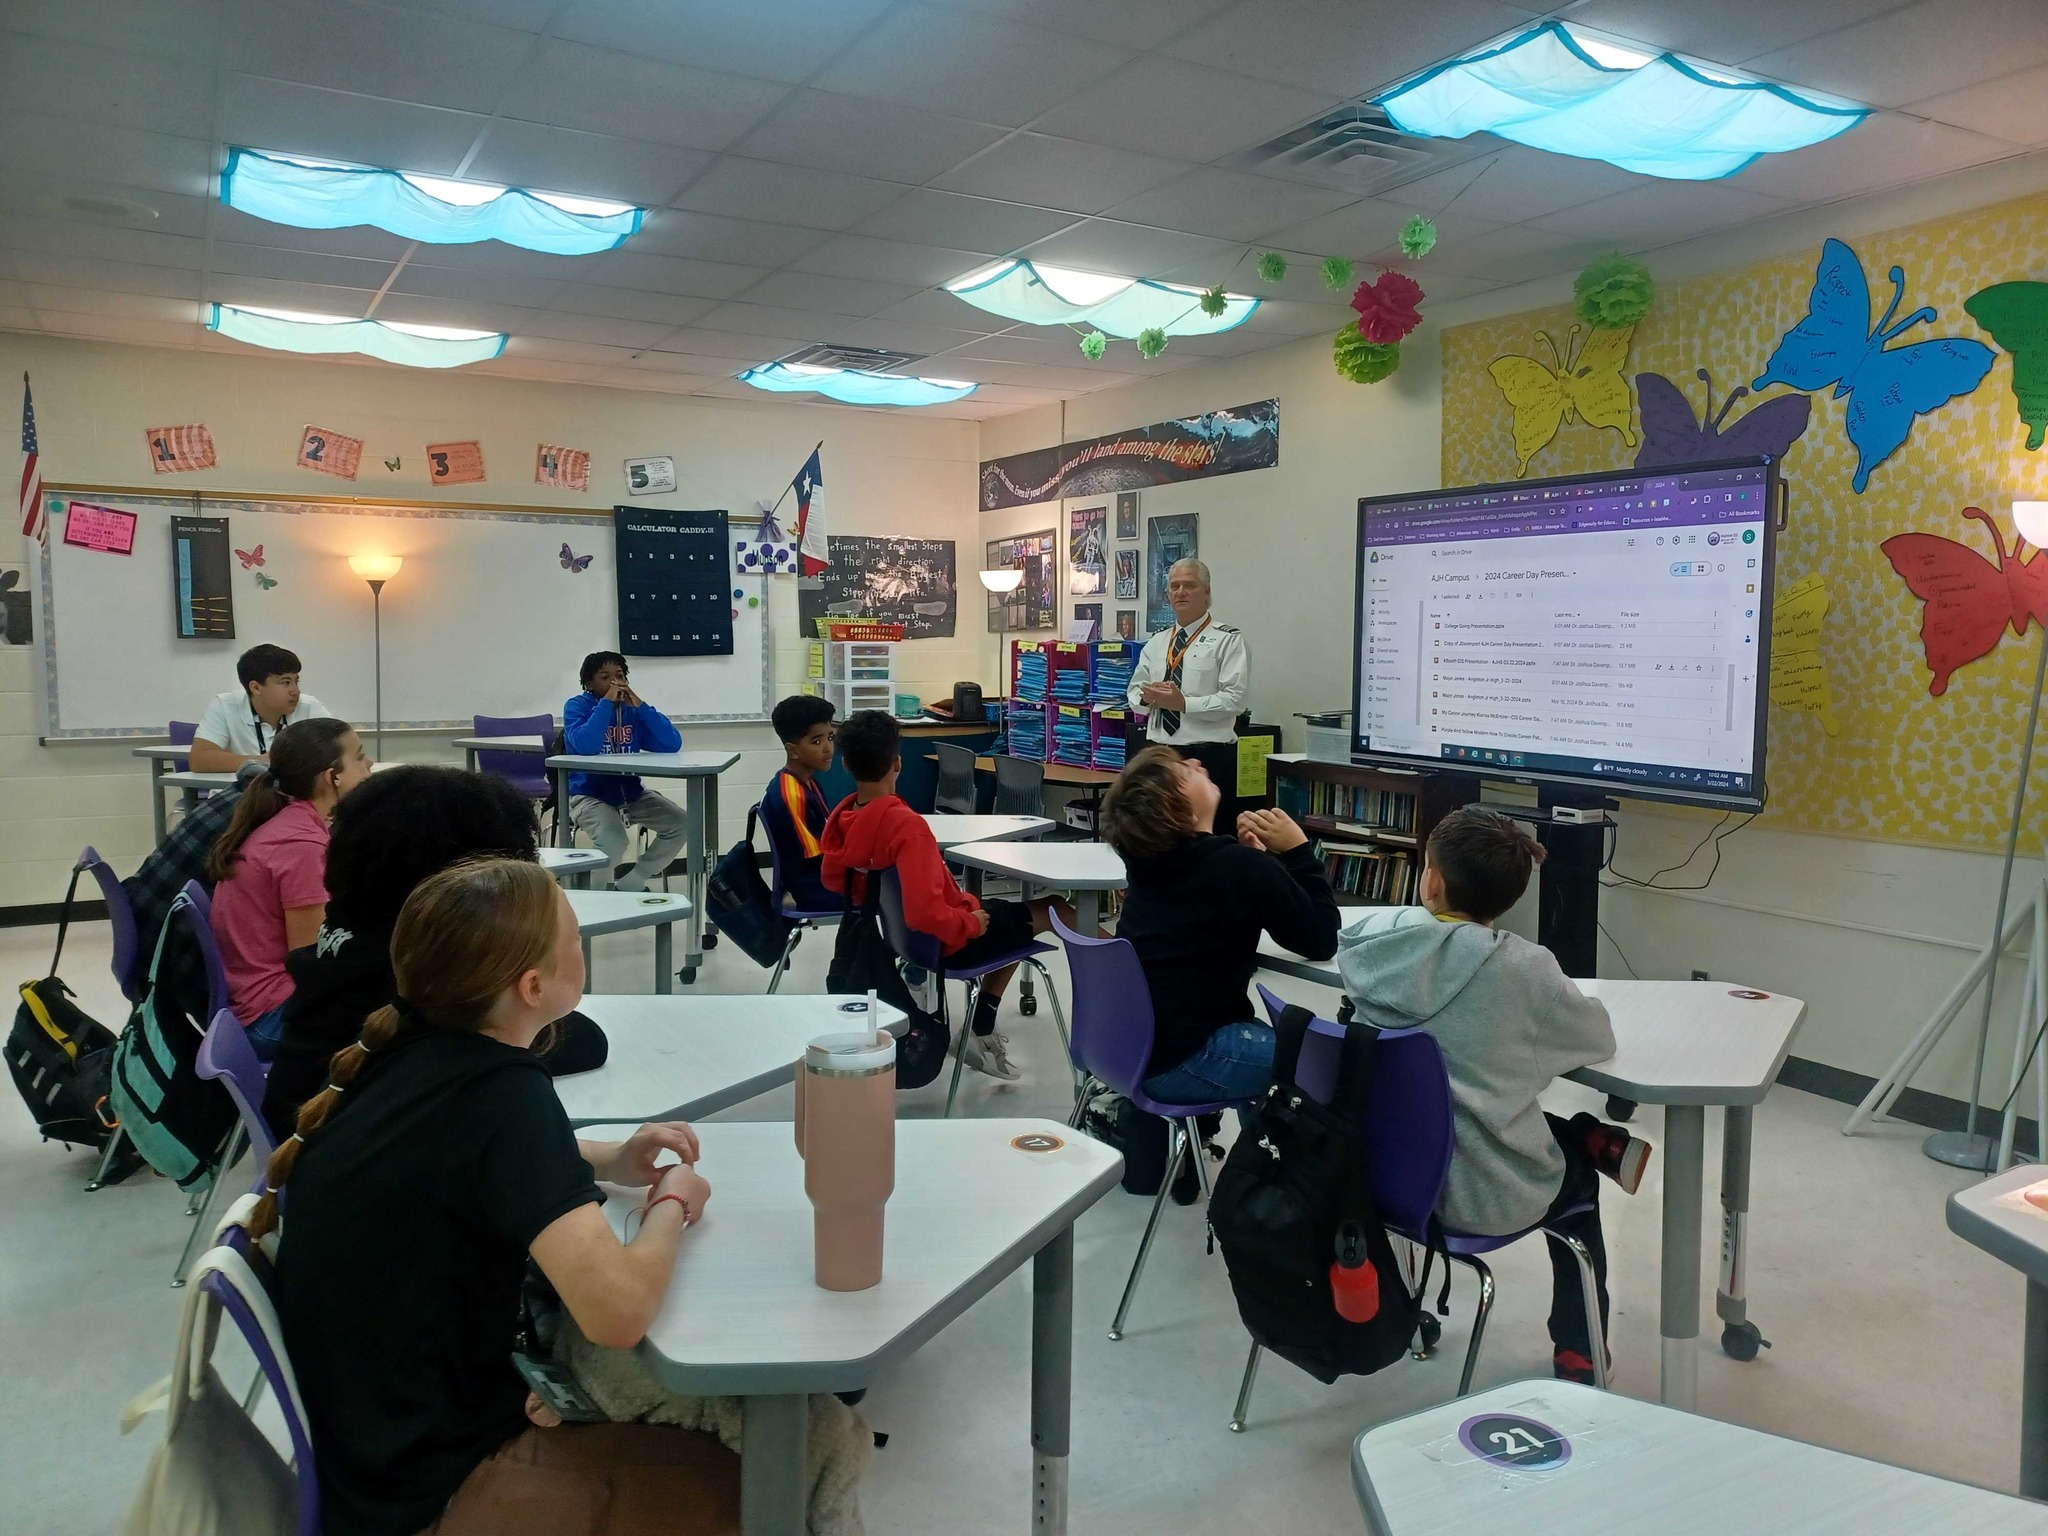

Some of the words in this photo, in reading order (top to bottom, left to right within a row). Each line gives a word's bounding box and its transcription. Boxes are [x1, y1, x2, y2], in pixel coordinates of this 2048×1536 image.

[152, 437, 176, 462] 1
[306, 435, 326, 462] 2
[431, 452, 449, 477] 3
[982, 464, 993, 483] Shoot
[1014, 485, 1025, 498] Even
[1029, 487, 1041, 501] you
[1060, 447, 1093, 479] you'll
[1092, 437, 1121, 459] land
[1117, 440, 1161, 462] among
[1158, 437, 1184, 462] the
[1180, 431, 1226, 465] stars!
[630, 464, 650, 489] 5
[627, 524, 677, 533] CALCULATOR
[827, 539, 859, 551] etimes
[865, 539, 880, 550] the
[844, 555, 861, 566] the
[898, 556, 934, 566] direction
[817, 571, 840, 582] Ends
[848, 572, 859, 583] up
[1431, 574, 1444, 582] AJH
[1444, 573, 1470, 583] Campus
[1484, 572, 1501, 581] 2024
[1502, 571, 1525, 580] Career
[1526, 570, 1540, 580] Day
[1540, 570, 1570, 578] Presen...
[842, 587, 862, 598] Step
[866, 608, 874, 617] if
[879, 611, 893, 620] you
[898, 611, 919, 620] must
[1616, 766, 1632, 775] Mostly
[1632, 768, 1648, 776] cloudy
[1489, 1427, 1545, 1455] 21
